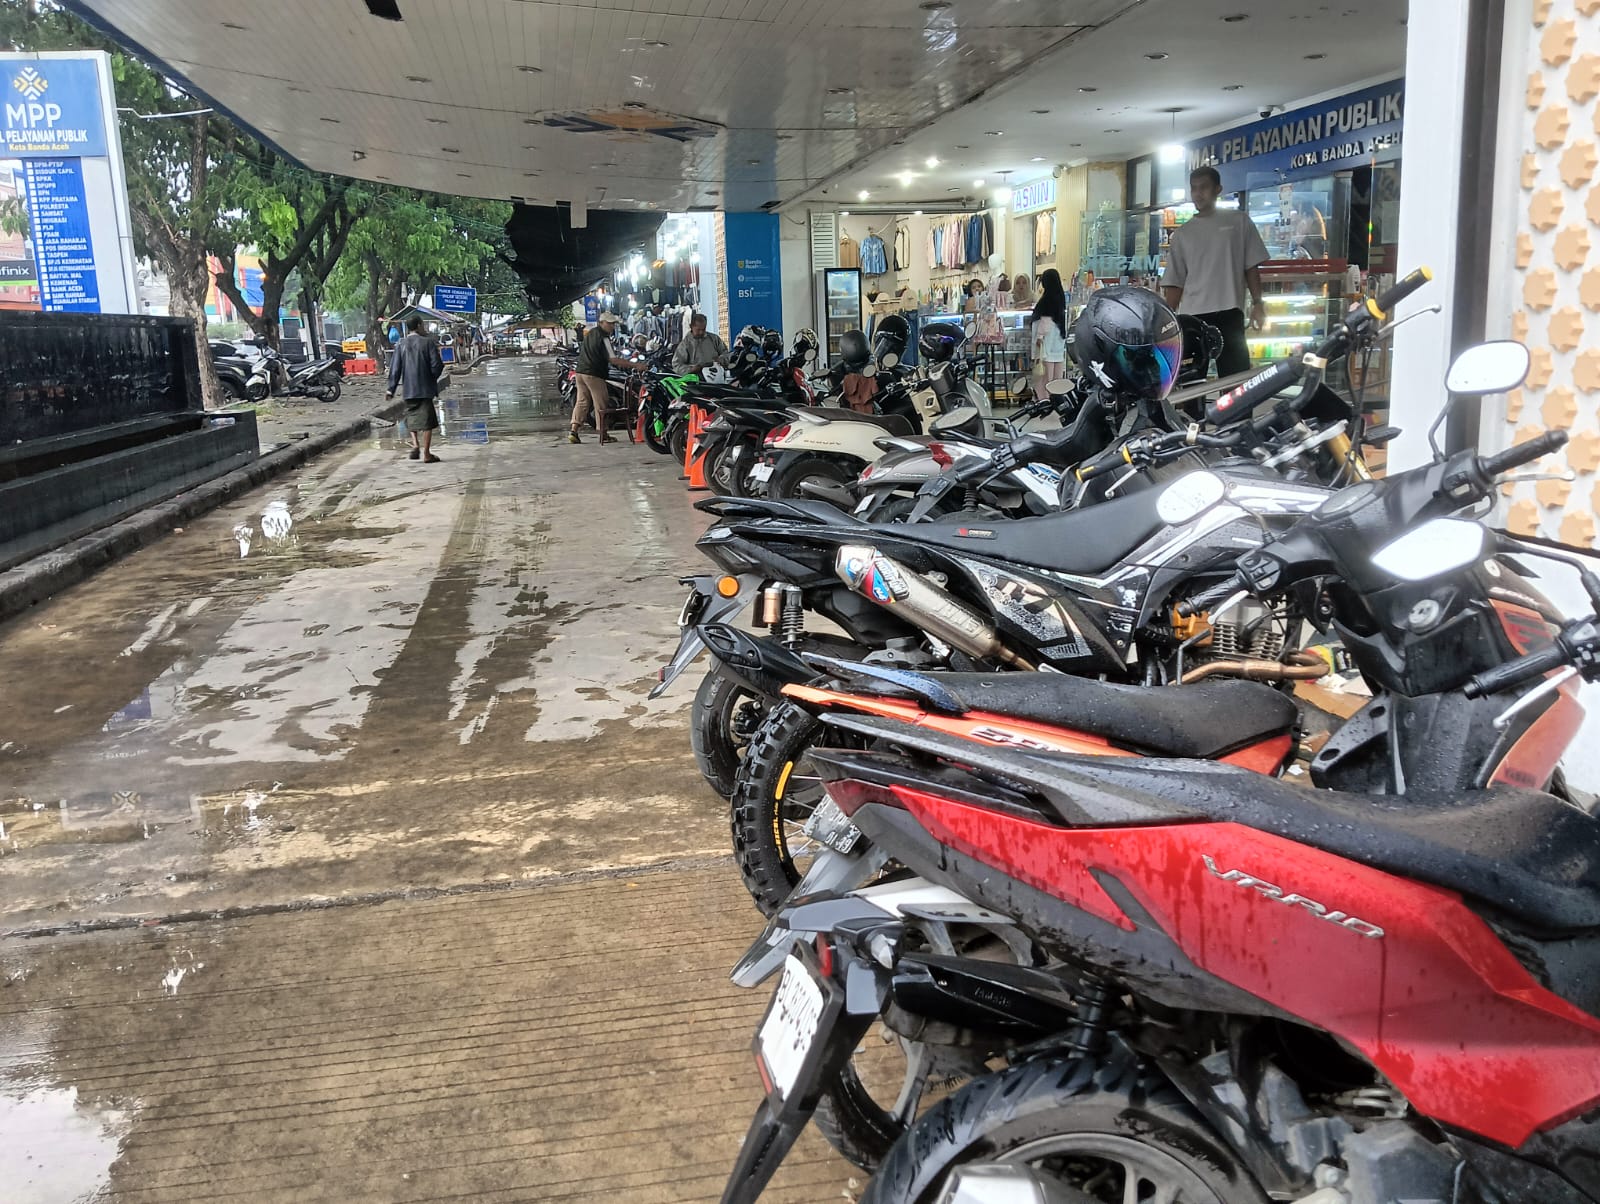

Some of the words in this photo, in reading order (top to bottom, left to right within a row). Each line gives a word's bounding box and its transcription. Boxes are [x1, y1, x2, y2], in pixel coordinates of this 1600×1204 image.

[6, 103, 61, 129] MPP
[6, 130, 55, 143] PELAYANAN
[56, 129, 88, 142] PUBLIK
[1189, 144, 1219, 171] MAL
[1223, 114, 1322, 163] PELAYANAN
[1326, 92, 1402, 136] PUBLIK
[9, 143, 26, 151] Kota
[27, 143, 50, 151] Banda
[52, 143, 69, 151] Aceh
[1291, 152, 1317, 168] KOTA
[1322, 141, 1360, 161] BANDA
[1367, 134, 1400, 152] ACEH
